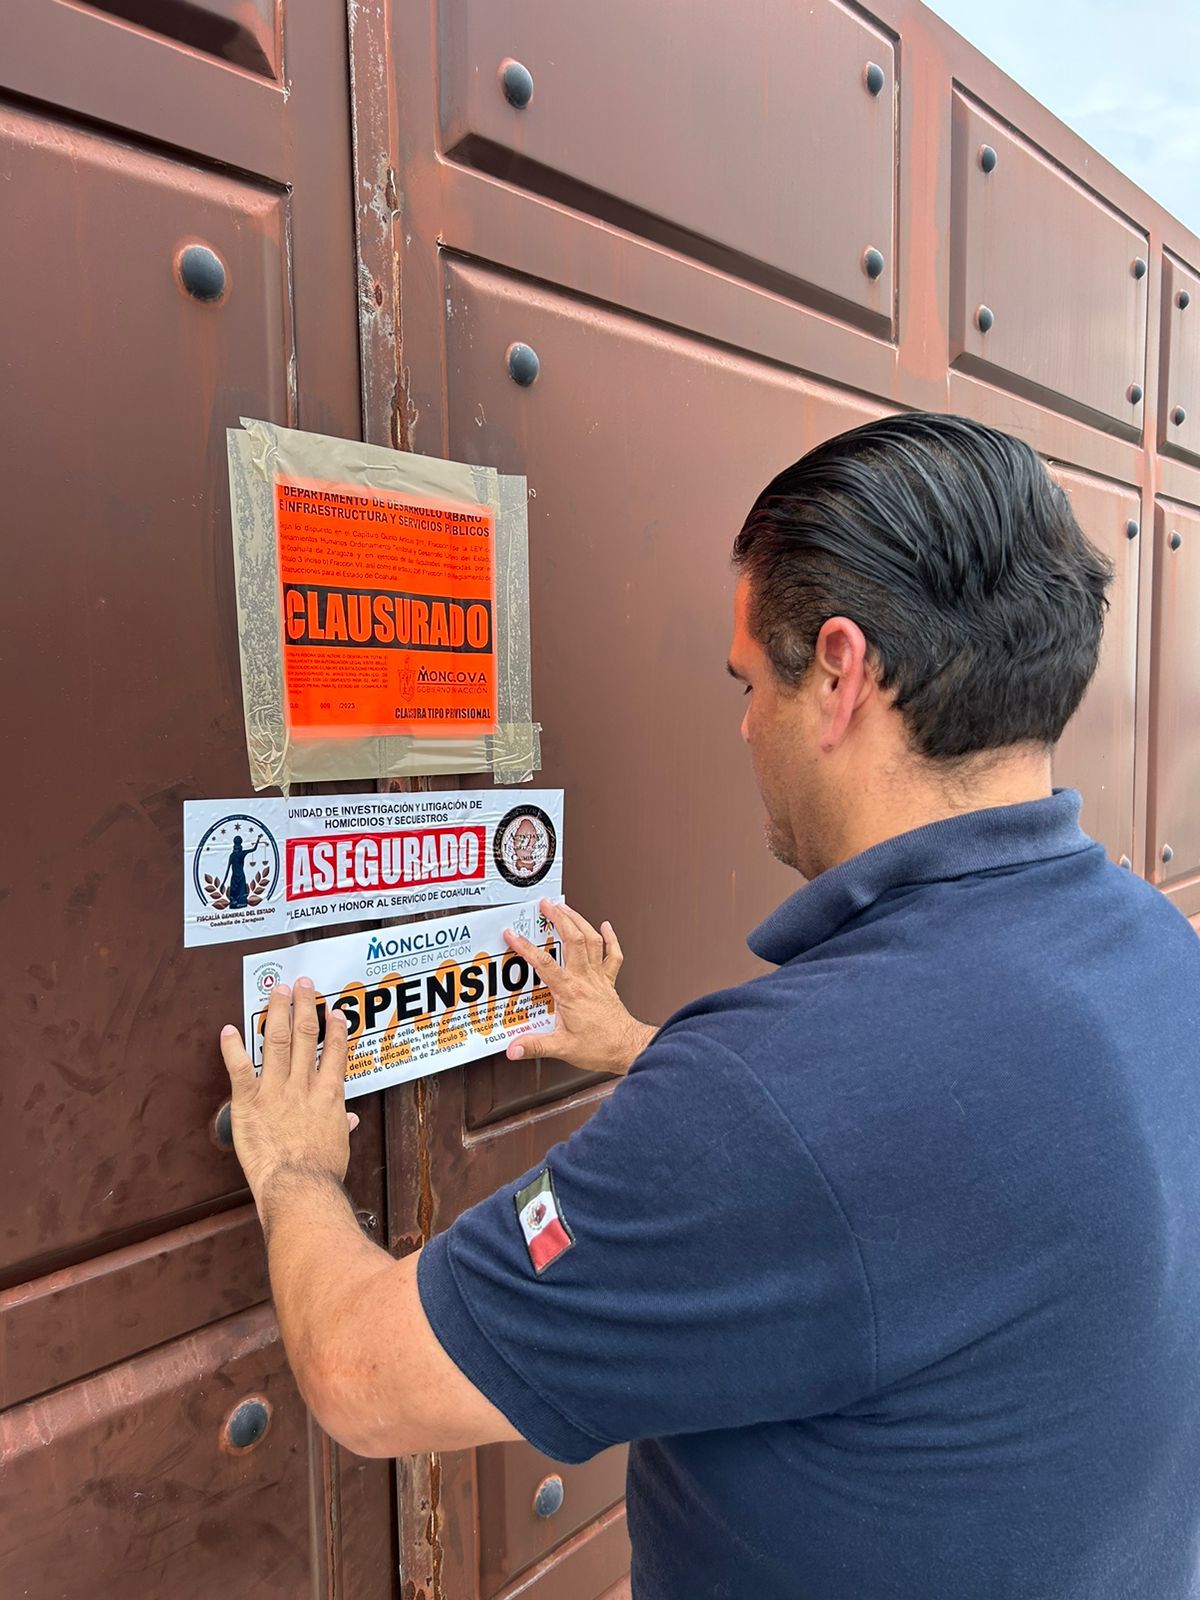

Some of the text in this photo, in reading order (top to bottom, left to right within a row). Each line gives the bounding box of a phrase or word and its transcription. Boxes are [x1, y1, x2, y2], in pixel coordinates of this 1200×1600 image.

[284, 486, 368, 506] DEPARTAMENTO
[372, 497, 384, 508] DE
[285, 501, 388, 523] INFRAESTRUCTURA
[390, 514, 396, 524] Y
[398, 515, 442, 532] SERVICIOS
[286, 590, 488, 648] CLAUSURADO
[428, 708, 444, 719] TIPO
[288, 799, 482, 818] UNIDAD DE INVESTIGACIÓN Y LITIGACIÓN DE
[325, 813, 448, 829] HOMICIDIOS Y SECUESTROS
[292, 832, 479, 895] ASEGURADO
[330, 904, 337, 912] Y
[339, 900, 373, 911] HONOR
[376, 899, 389, 908] AL
[391, 894, 426, 906] SERVICIO
[428, 892, 438, 900] DE
[367, 926, 471, 960] MONCLOVA
[366, 944, 472, 977] GOBIERNO EN ACCIÓN
[378, 1034, 395, 1042] este
[397, 1028, 415, 1037] sello
[442, 1016, 461, 1025] como
[463, 1002, 510, 1019] consecuencia
[422, 1015, 492, 1039] Independientemente
[504, 1008, 514, 1016] las
[350, 1058, 372, 1071] delito
[374, 1048, 409, 1064] tipificado
[525, 1011, 536, 1020] Ley
[485, 1033, 506, 1044] FOLIO
[344, 1070, 371, 1082] Estado
[385, 1055, 418, 1069] Coahuila
